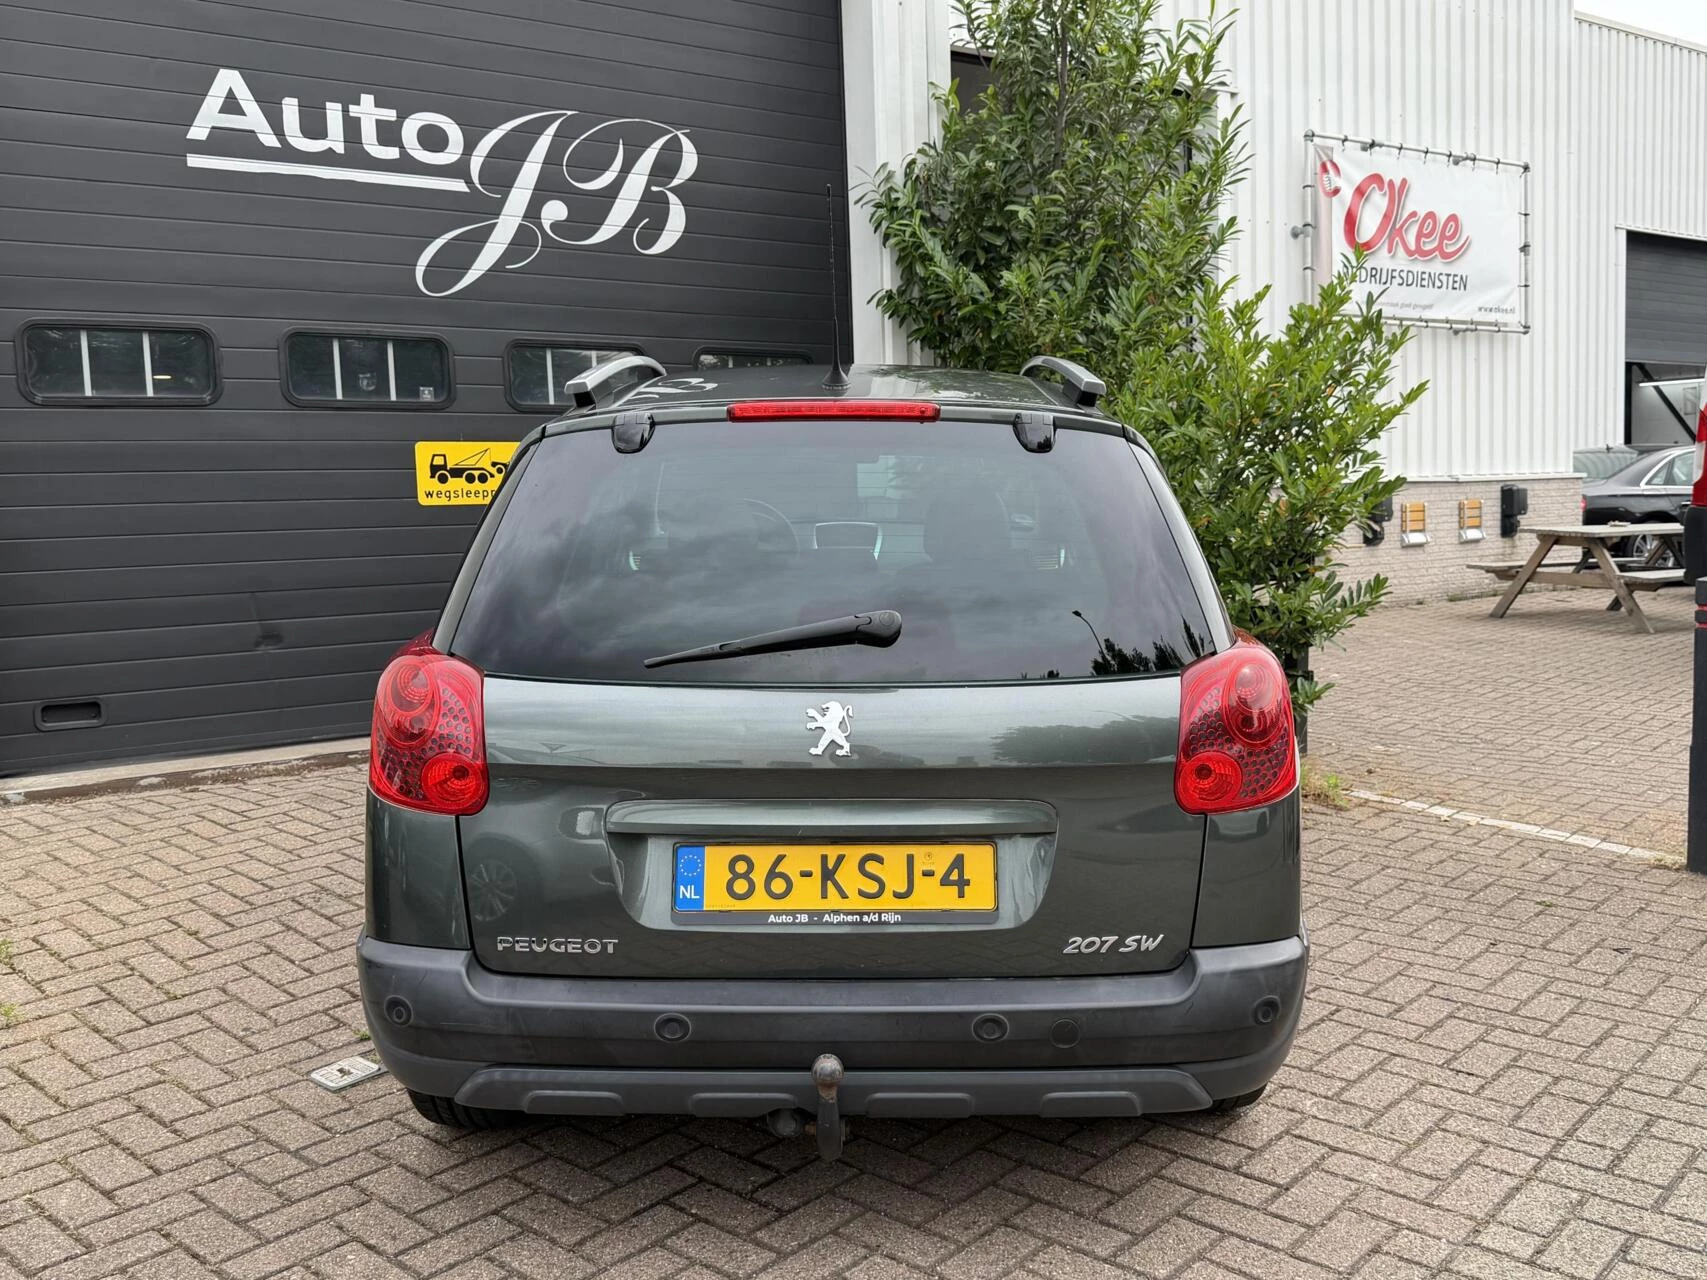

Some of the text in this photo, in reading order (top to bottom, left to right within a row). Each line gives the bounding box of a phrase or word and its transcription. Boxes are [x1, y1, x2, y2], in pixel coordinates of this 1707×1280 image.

[186, 69, 698, 297] Auto JB
[1343, 265, 1468, 291] DRIJFSDIENSTEN
[725, 853, 971, 901] 86-KSJ-4
[679, 885, 700, 899] NL
[768, 914, 793, 923] Auto
[795, 914, 809, 923] JB
[823, 913, 860, 924] Alphen
[862, 913, 879, 923] a/d
[881, 912, 902, 923] Rijn
[497, 936, 619, 954] PEUGEOT
[1062, 934, 1165, 954] 207 SW
